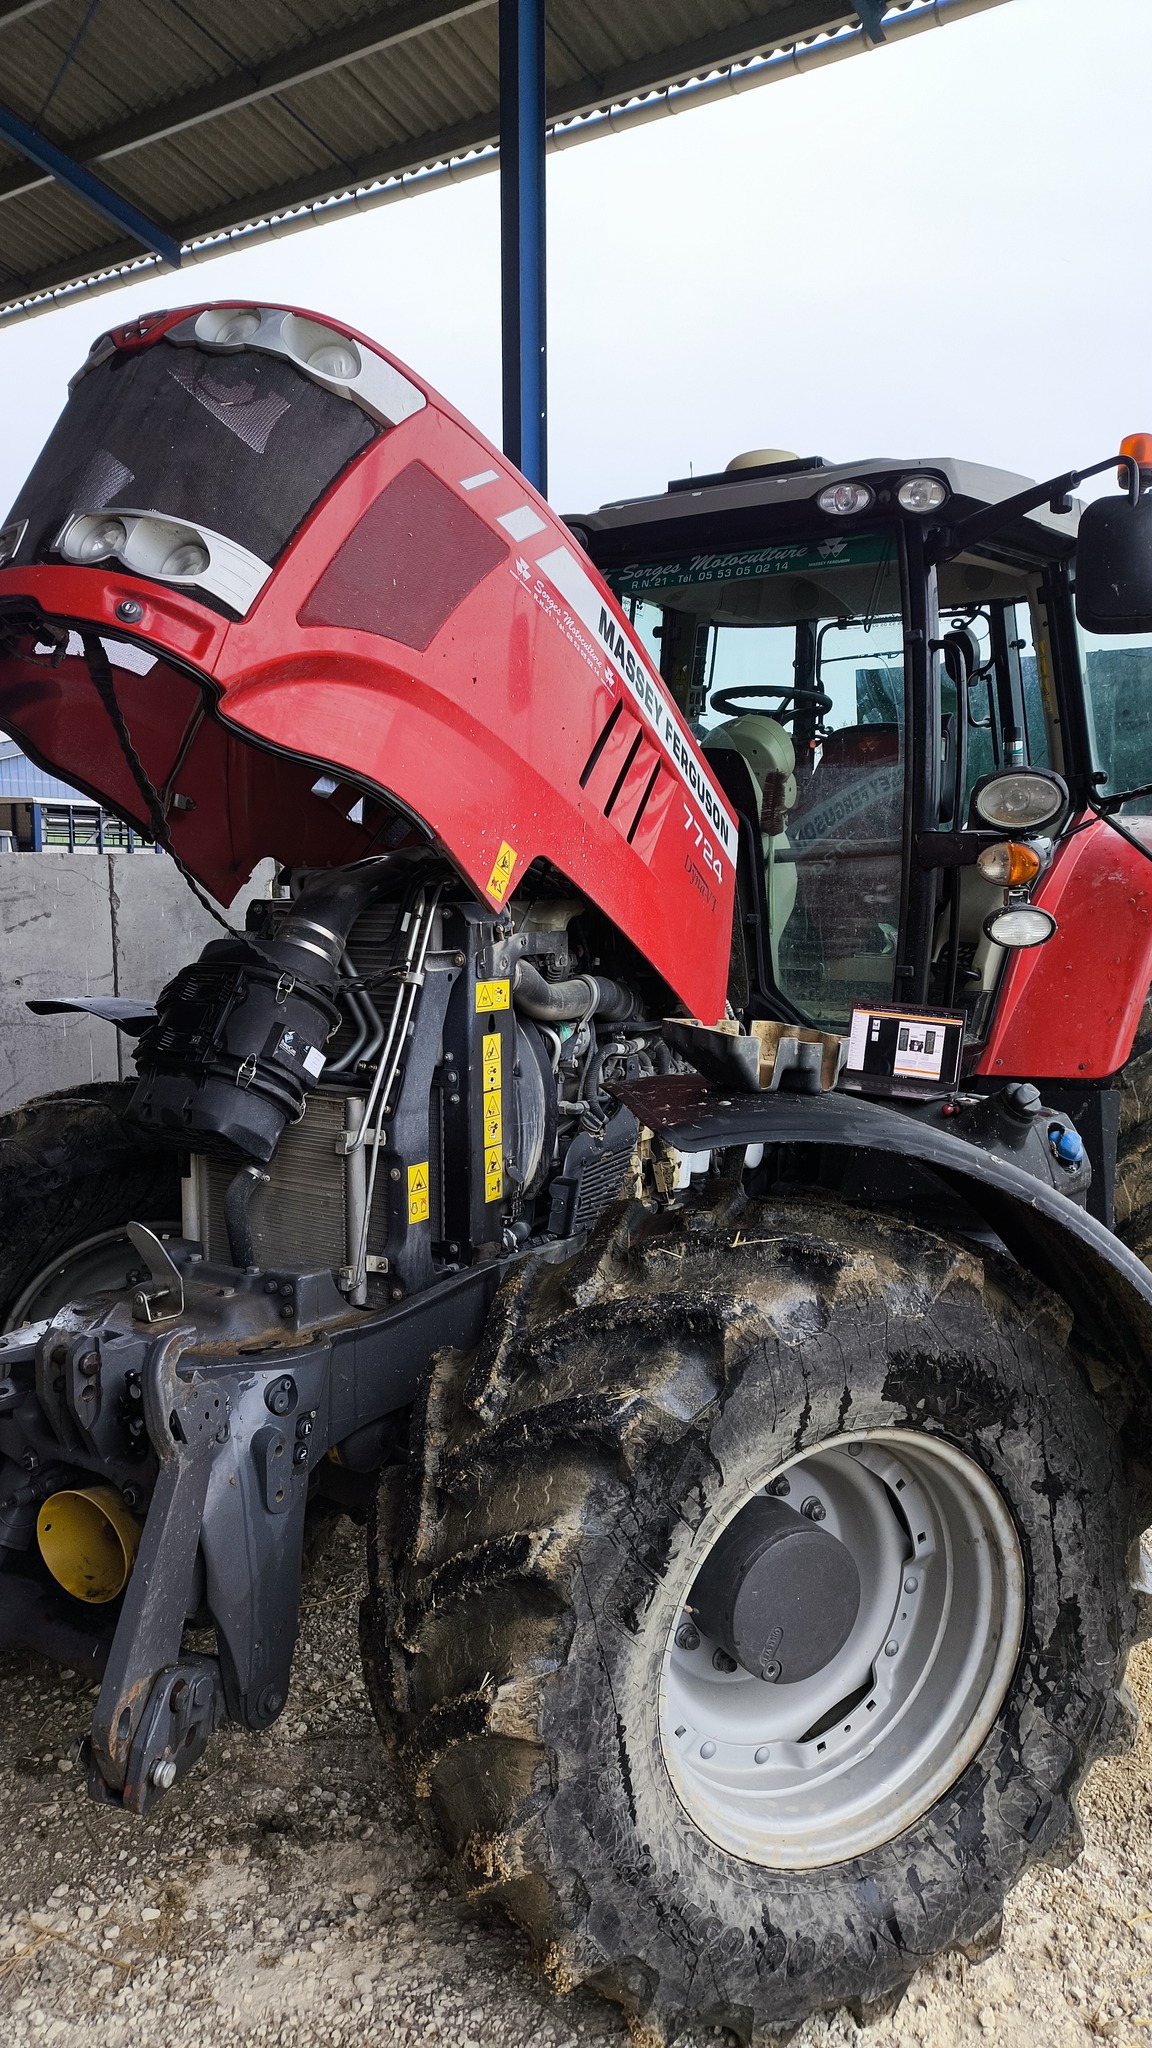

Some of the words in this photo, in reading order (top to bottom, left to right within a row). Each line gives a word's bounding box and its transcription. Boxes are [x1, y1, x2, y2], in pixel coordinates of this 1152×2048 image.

[618, 564, 681, 582] Sorges
[690, 547, 808, 571] Motoculture
[655, 577, 667, 586] 21
[678, 574, 693, 583] Tél.
[698, 571, 712, 581] 05
[717, 568, 731, 579] 53
[736, 566, 751, 576] 05
[755, 563, 770, 574] 02
[775, 561, 789, 571] 14
[534, 580, 562, 616] Sorges
[563, 610, 603, 668] Motoculture
[598, 605, 664, 727] MASSEY
[665, 716, 729, 847] FERGUSON
[683, 802, 723, 885] 7724
